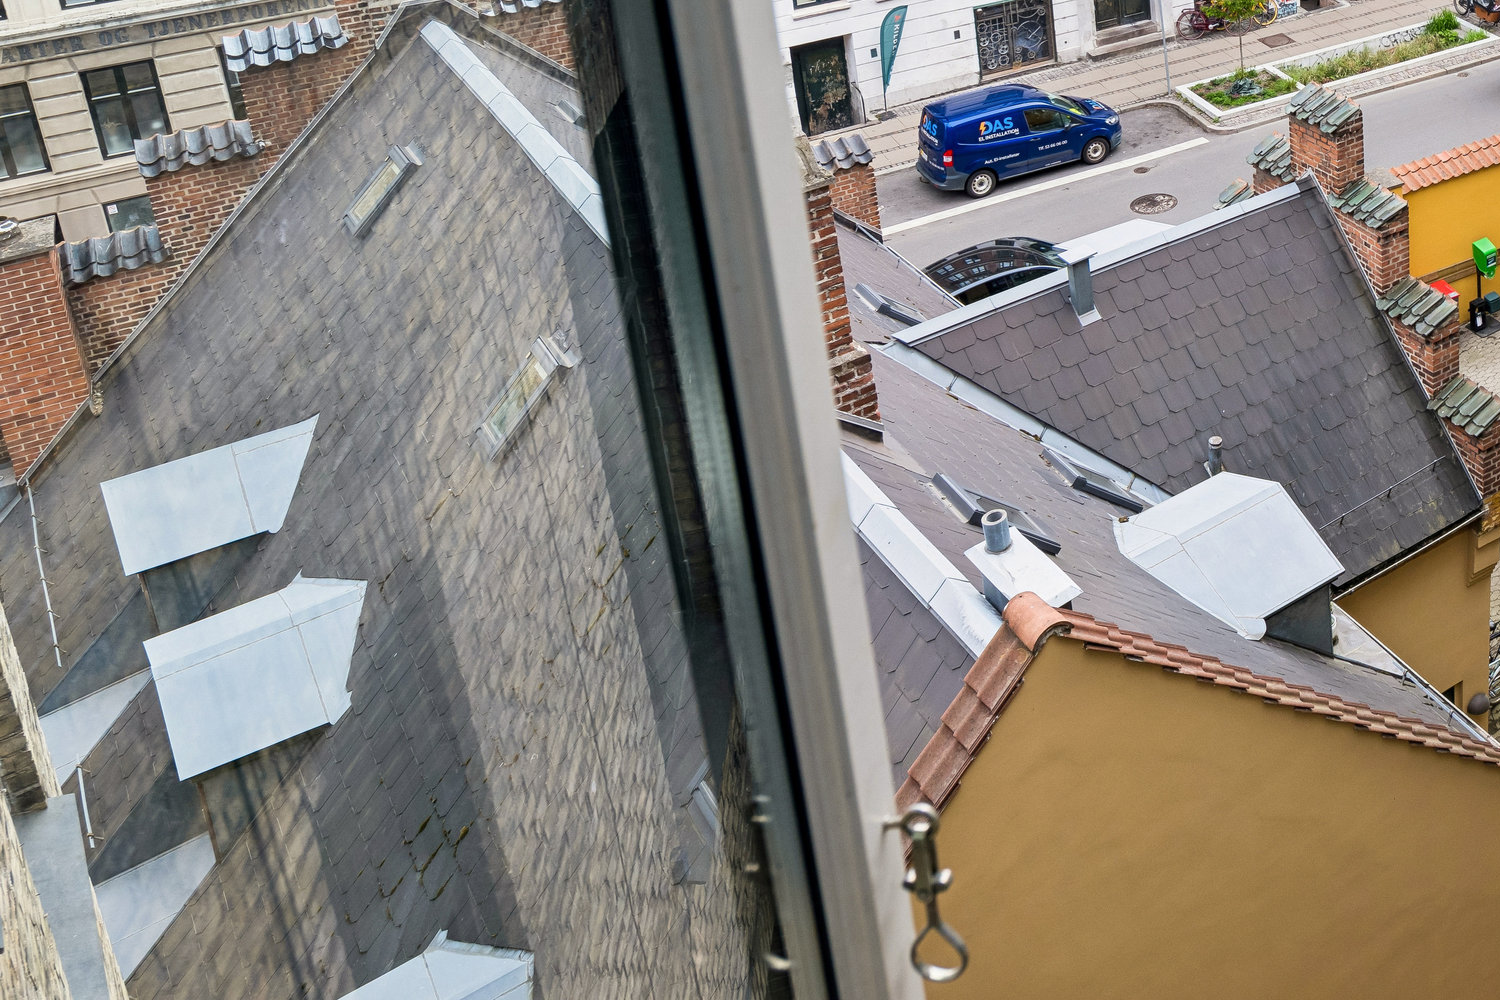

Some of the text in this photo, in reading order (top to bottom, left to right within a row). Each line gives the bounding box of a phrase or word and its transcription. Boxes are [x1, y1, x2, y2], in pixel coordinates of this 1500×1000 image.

[98, 28, 129, 46] OG
[979, 117, 1014, 135] DAS
[985, 128, 1020, 140] INSTALLATION
